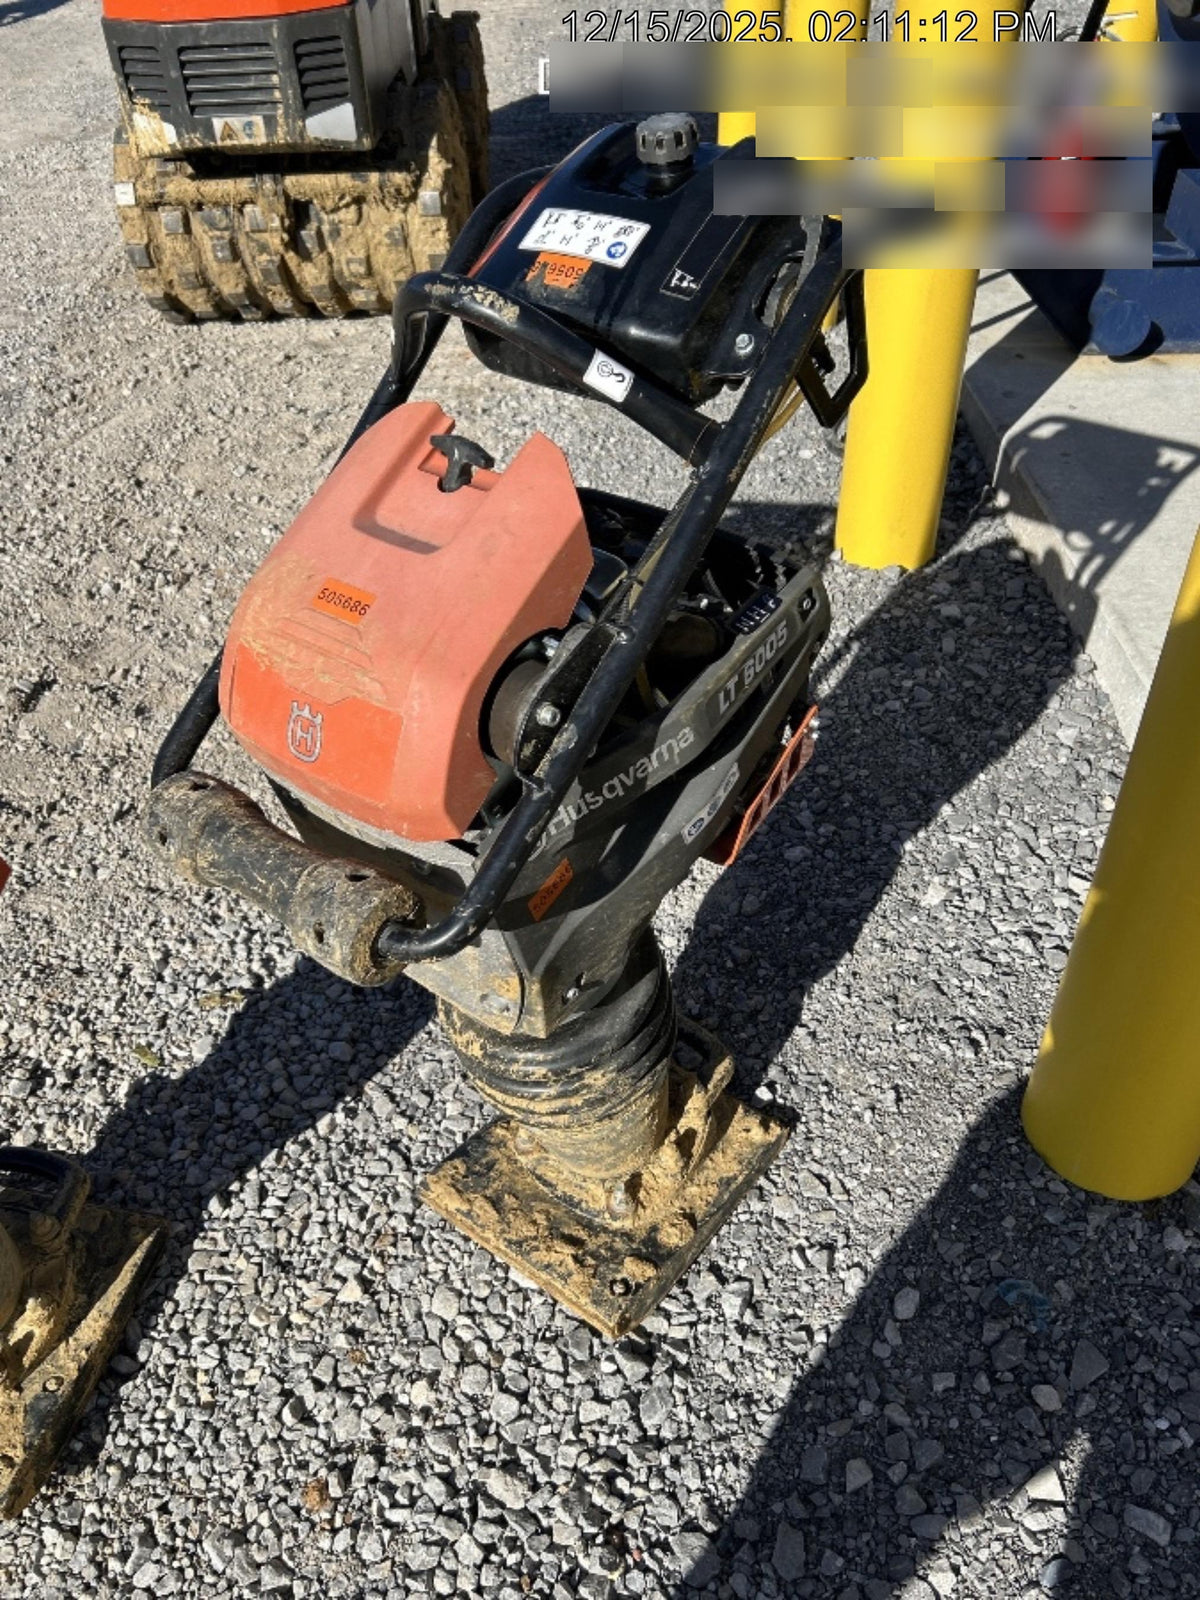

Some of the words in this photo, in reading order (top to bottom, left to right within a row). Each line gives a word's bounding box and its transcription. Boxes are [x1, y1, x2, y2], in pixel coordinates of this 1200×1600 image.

[529, 261, 585, 280] 5056
[317, 587, 371, 616] 505686
[718, 674, 739, 715] LT
[743, 619, 788, 686] 6005
[547, 726, 695, 837] Husqvarna
